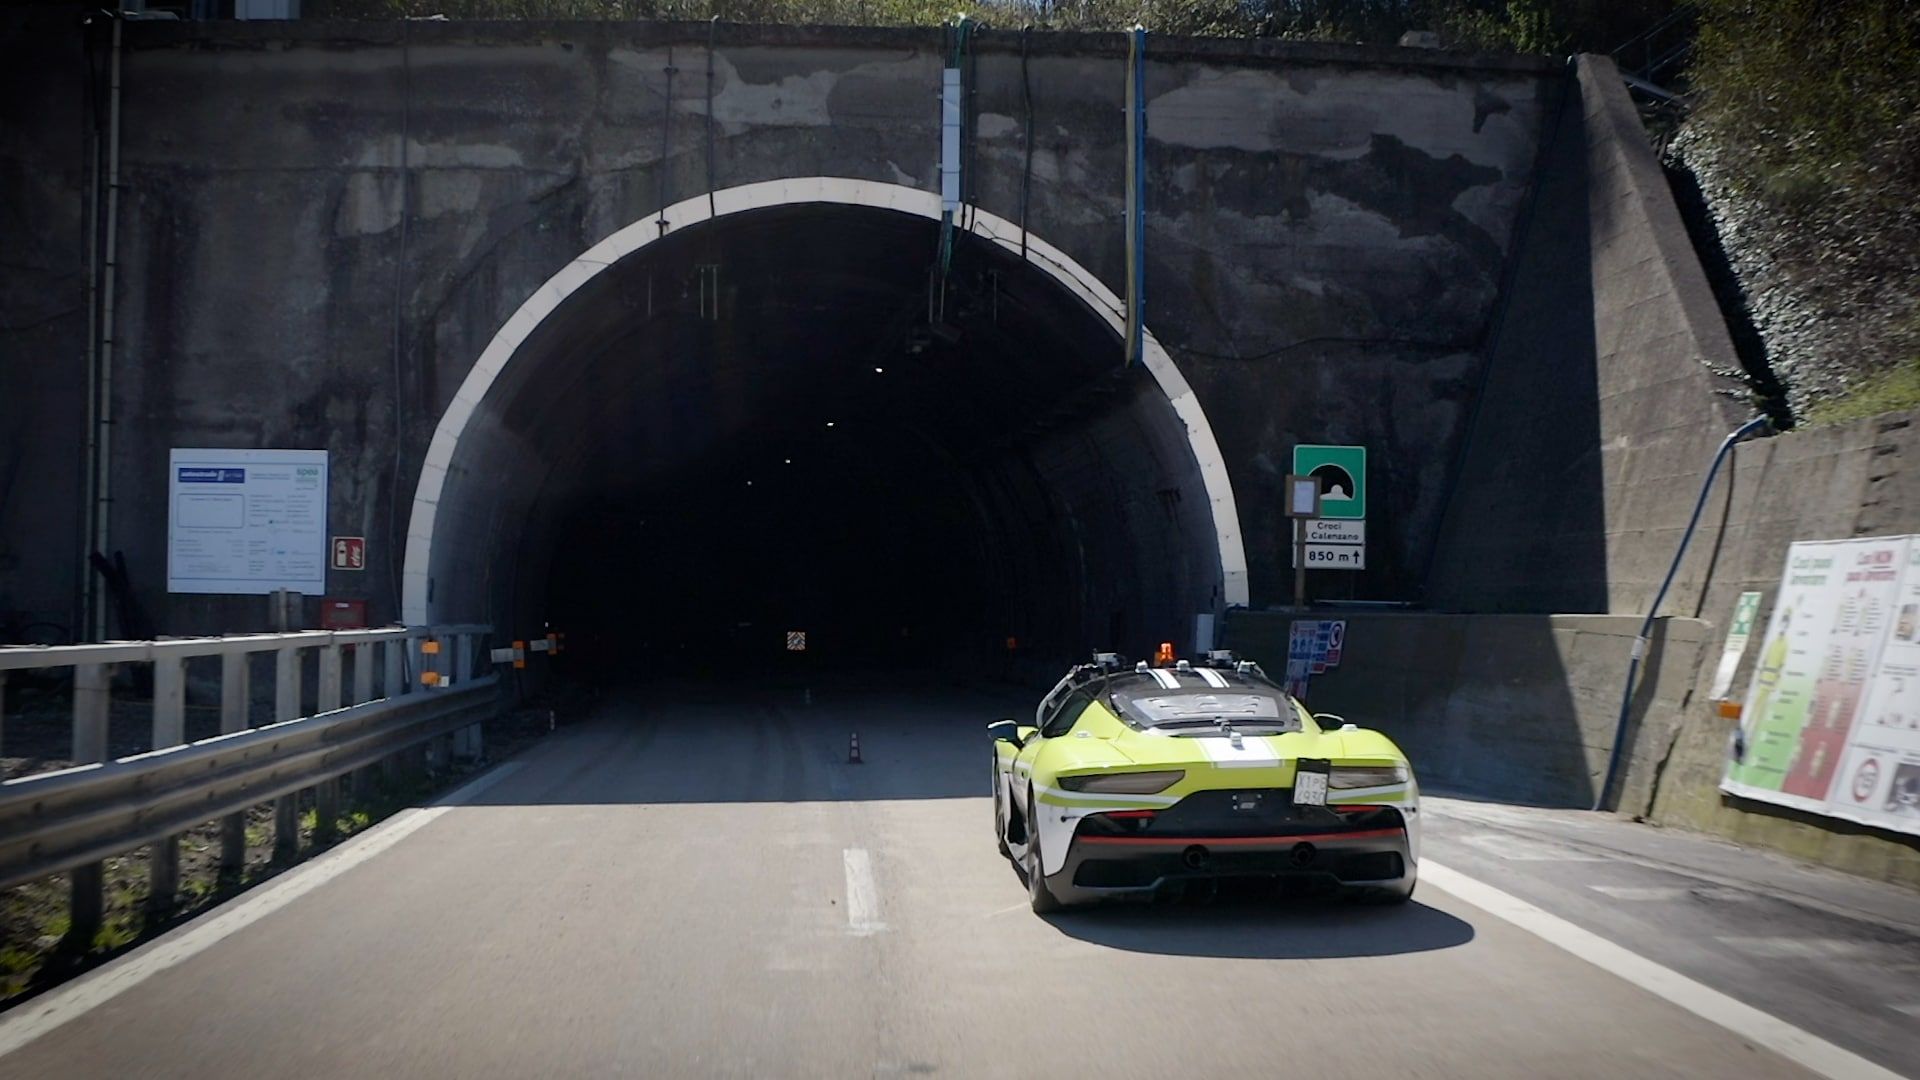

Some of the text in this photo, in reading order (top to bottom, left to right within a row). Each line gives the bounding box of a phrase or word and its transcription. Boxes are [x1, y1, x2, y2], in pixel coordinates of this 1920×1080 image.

[1317, 522, 1342, 530] Croci
[1311, 531, 1359, 540] Calenzano
[1309, 551, 1349, 562] 850 m
